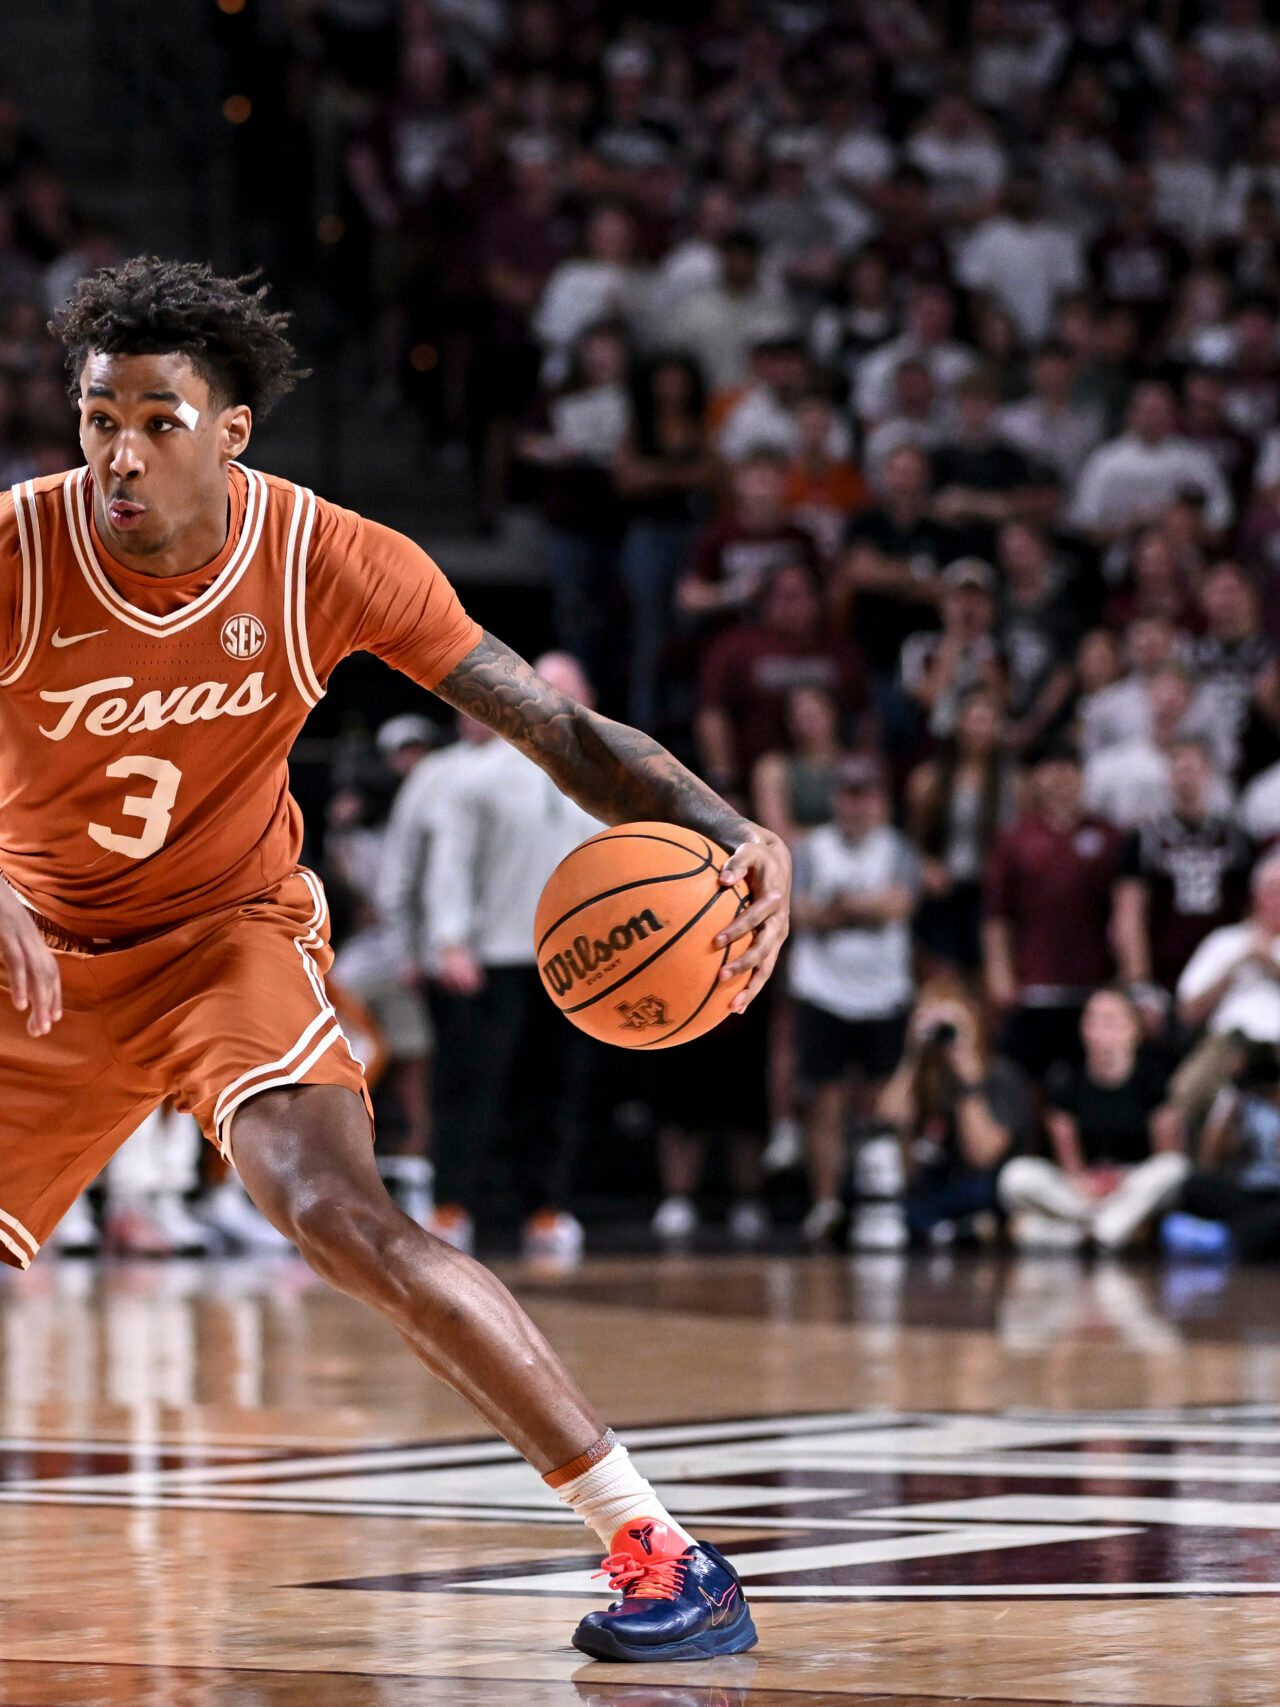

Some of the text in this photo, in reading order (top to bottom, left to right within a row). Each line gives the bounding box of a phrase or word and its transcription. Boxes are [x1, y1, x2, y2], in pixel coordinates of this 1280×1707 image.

[225, 617, 263, 657] SEC
[38, 671, 277, 741] Texas
[87, 755, 182, 859] 3
[543, 908, 664, 997] Wilson
